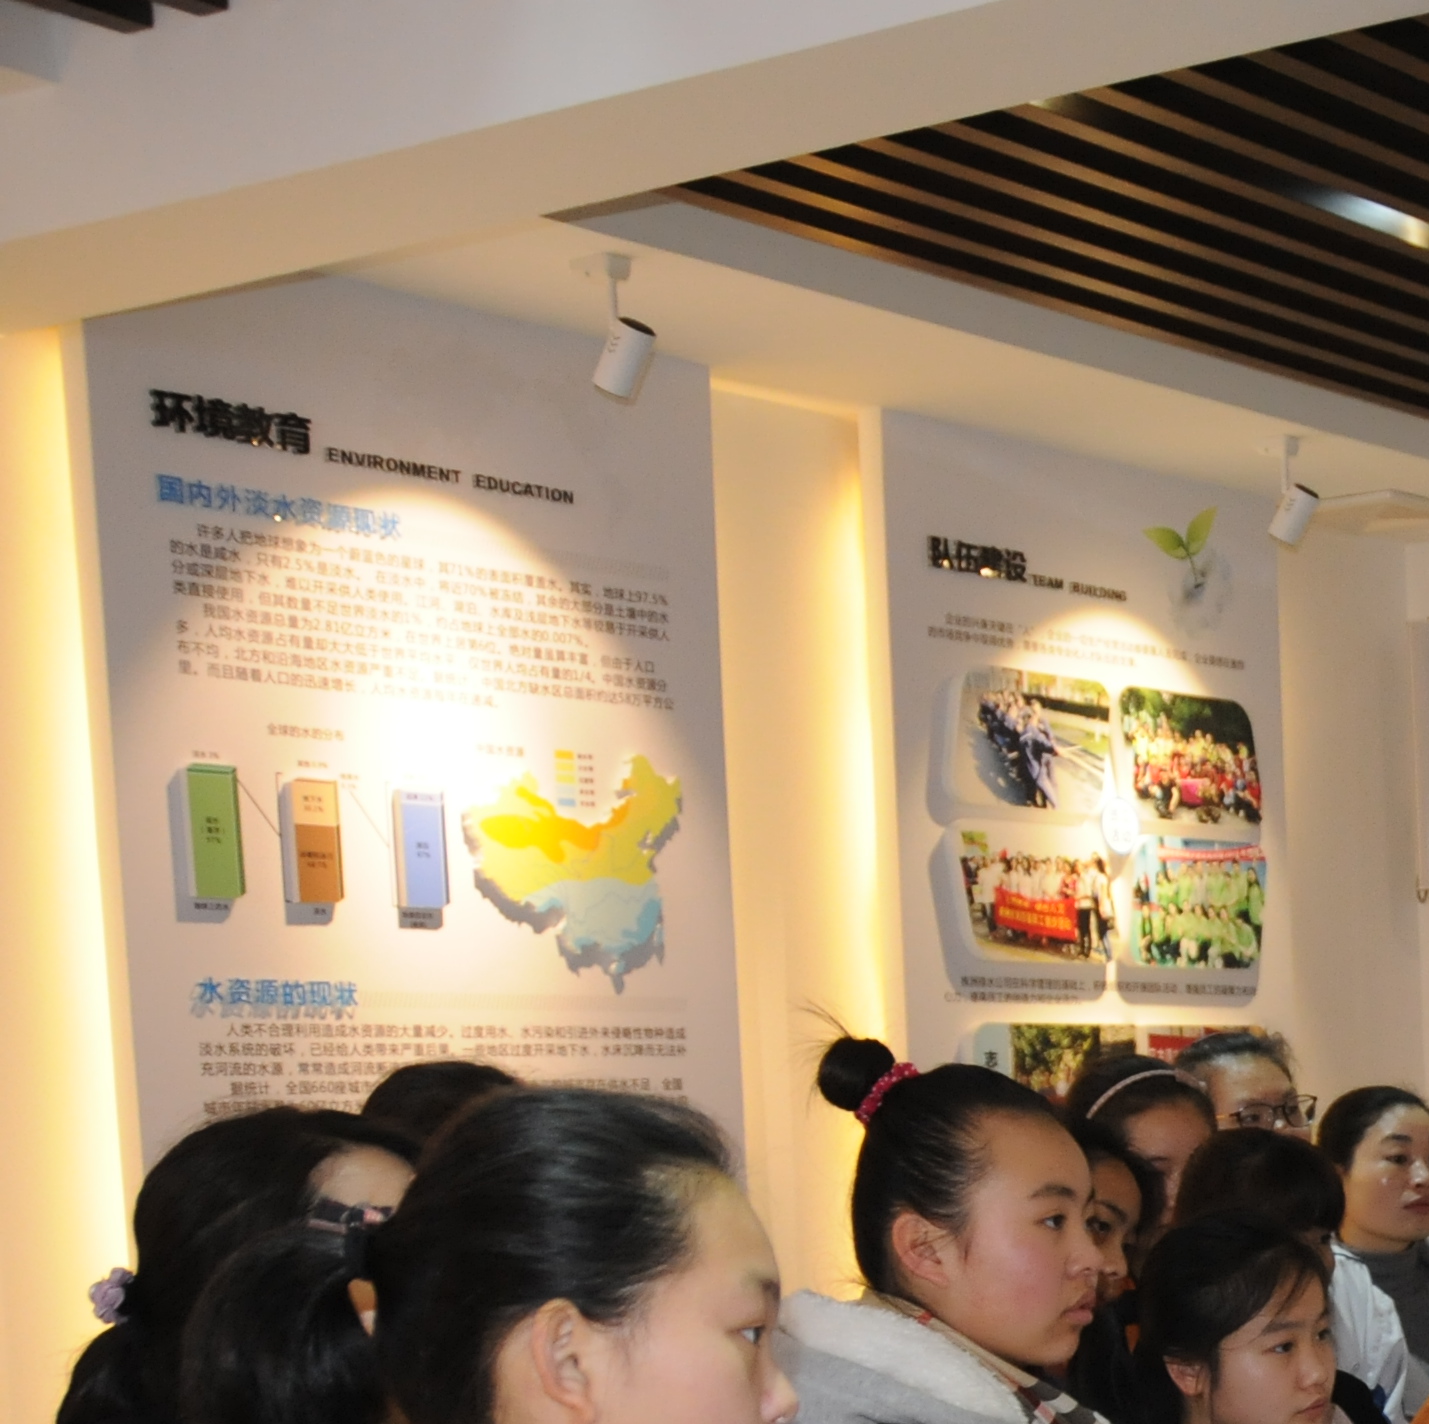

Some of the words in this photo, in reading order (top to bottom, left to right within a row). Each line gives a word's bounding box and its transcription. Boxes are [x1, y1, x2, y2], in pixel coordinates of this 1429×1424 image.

[149, 388, 312, 456] 环境教育
[325, 447, 461, 485] ENVIRONMENT
[473, 473, 574, 504] EDUCATION
[155, 473, 400, 541] 国内外淡水资源现状
[927, 535, 1027, 583] 队伍建设
[1033, 573, 1064, 590] TEAM
[1069, 581, 1126, 601] BUILDING
[195, 977, 358, 1007] 水资源的现状
